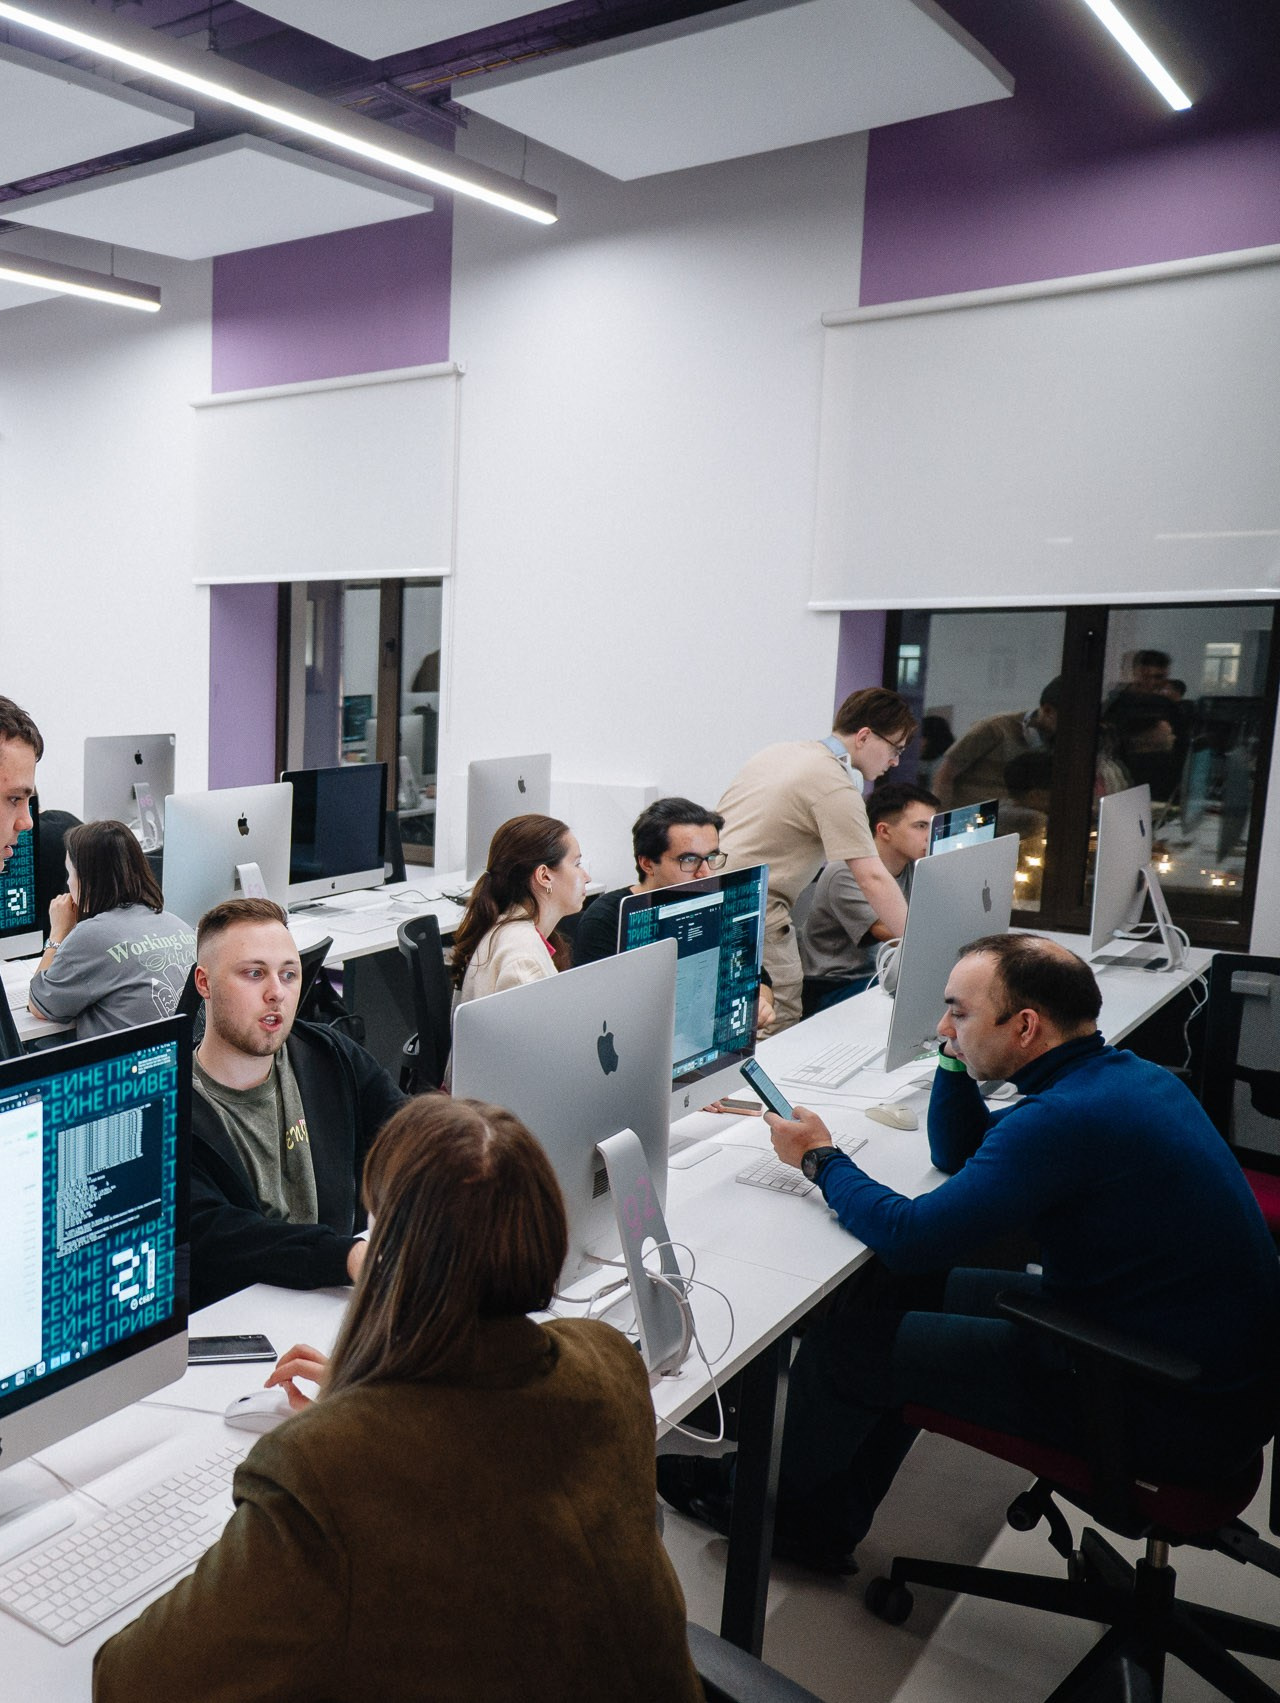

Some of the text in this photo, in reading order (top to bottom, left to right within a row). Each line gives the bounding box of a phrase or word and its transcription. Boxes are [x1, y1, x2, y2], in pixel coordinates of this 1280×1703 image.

[7, 887, 27, 911] 21
[106, 933, 183, 964] Working
[107, 1067, 178, 1108] ПРИВЕТ
[112, 1241, 155, 1302] 21
[106, 1294, 175, 1345] ПРИВЕТ
